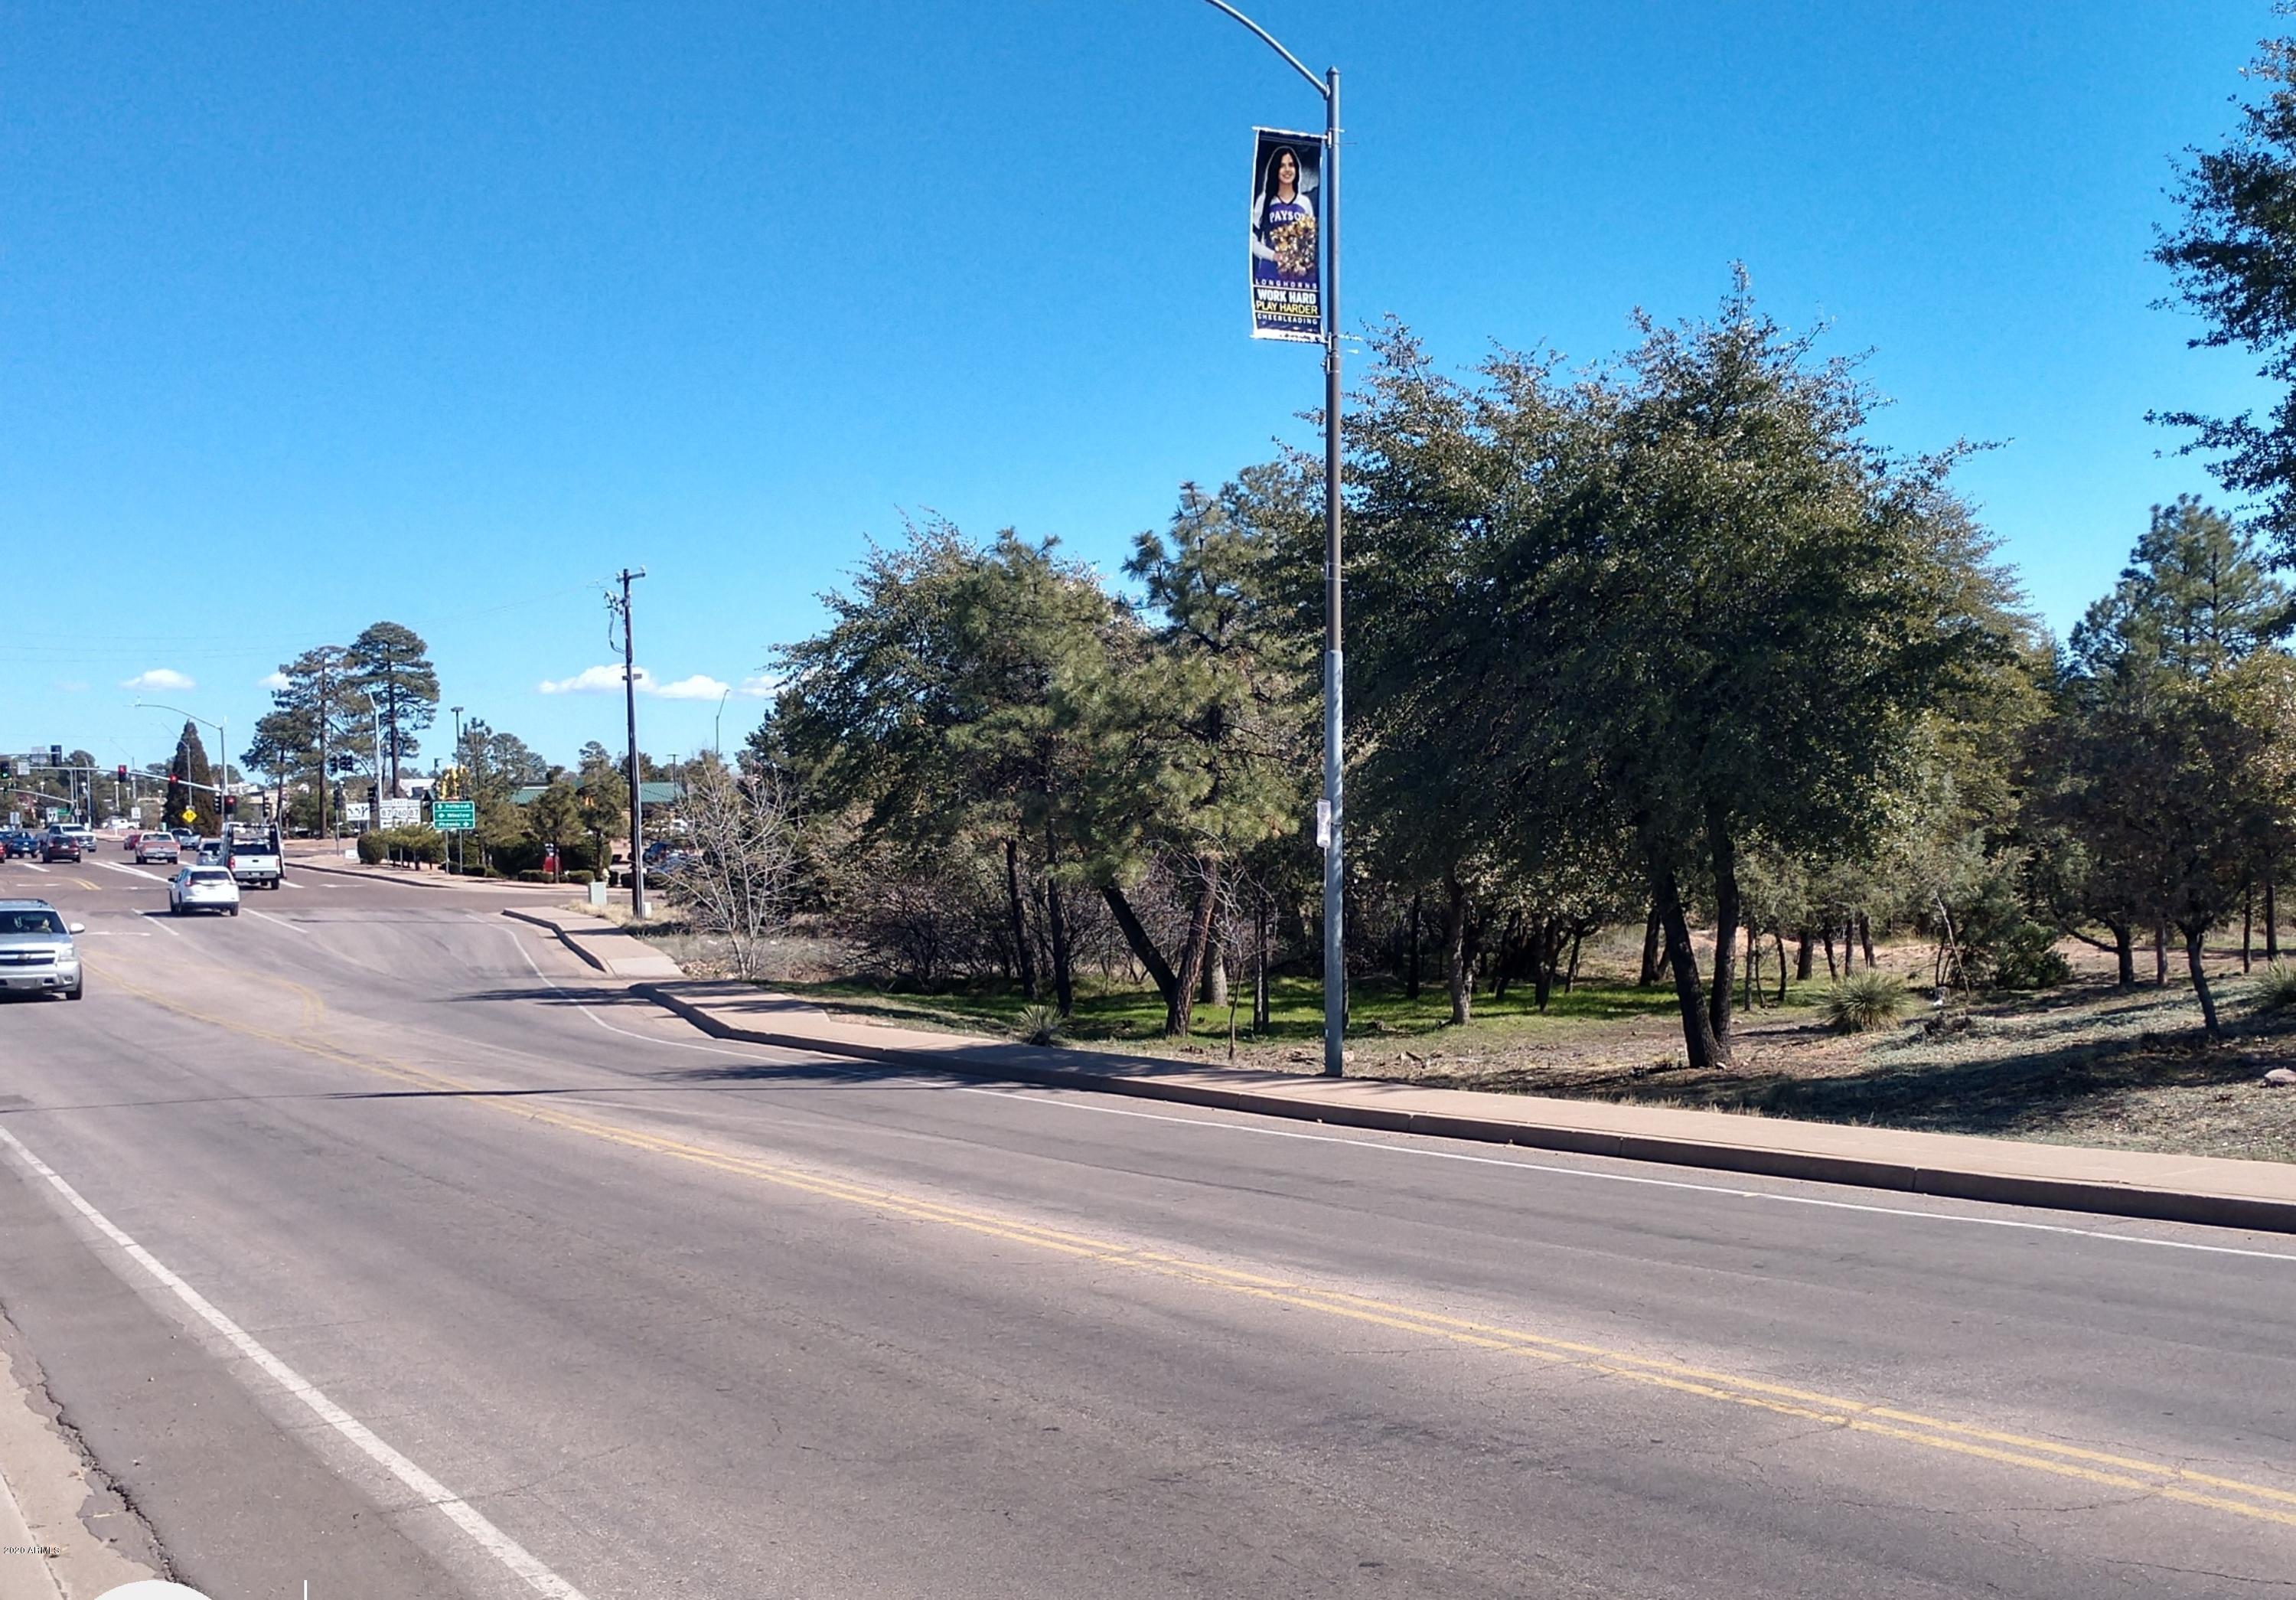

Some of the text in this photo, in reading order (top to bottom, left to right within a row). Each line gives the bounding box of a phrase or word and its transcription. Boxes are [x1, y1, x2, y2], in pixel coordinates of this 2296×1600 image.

[1255, 278, 1317, 290] LONGHORNS
[1257, 289, 1316, 305] WORK HARD
[1256, 300, 1318, 315] PLAY HARDER
[1257, 313, 1318, 325] CHEERLEADING
